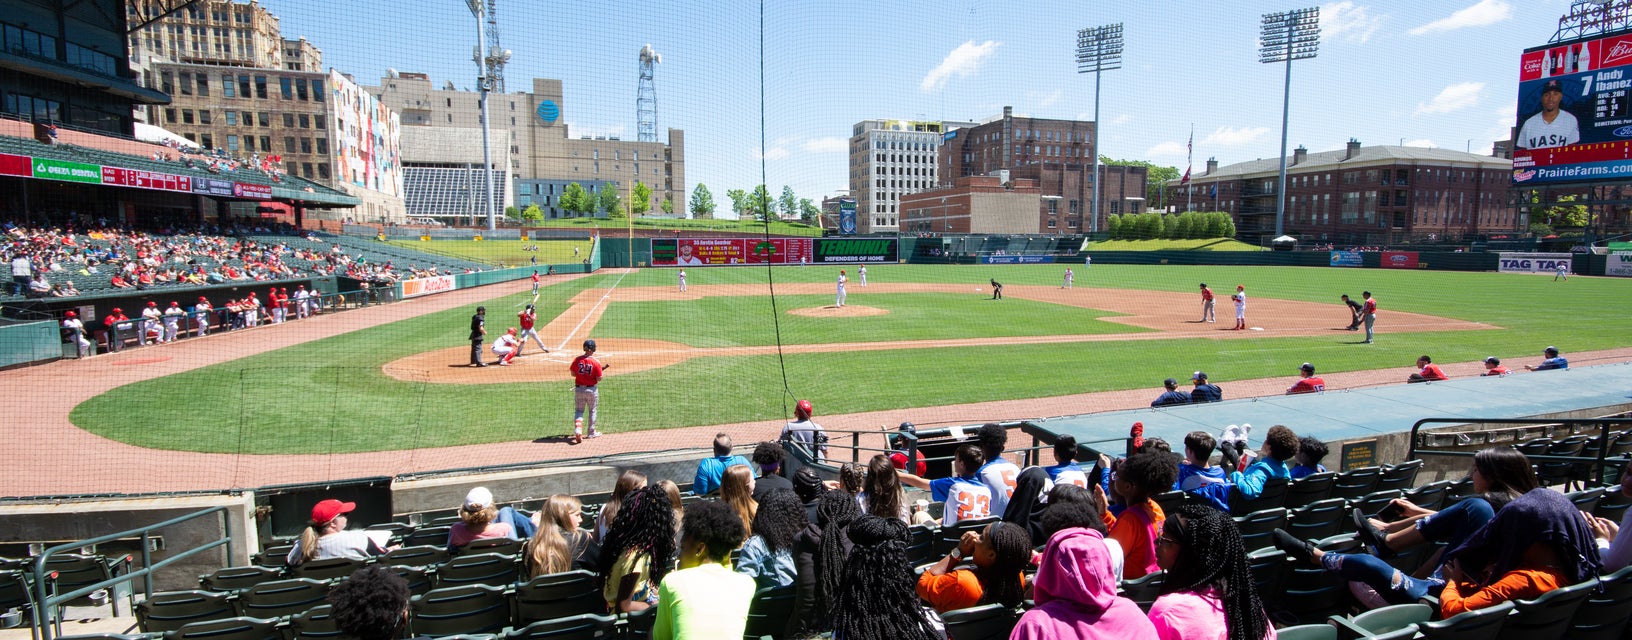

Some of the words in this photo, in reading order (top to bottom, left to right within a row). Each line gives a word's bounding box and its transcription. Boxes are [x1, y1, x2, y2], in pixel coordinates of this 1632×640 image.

[1597, 69, 1623, 81] Andy
[1581, 75, 1593, 96] 7
[1596, 79, 1632, 91] Ibanez
[71, 169, 98, 178] DENTAL
[820, 241, 891, 255] TERMINIX
[1501, 260, 1531, 269] TAG
[1536, 260, 1568, 270] TAG
[578, 363, 592, 375] 24
[957, 491, 989, 520] 23
